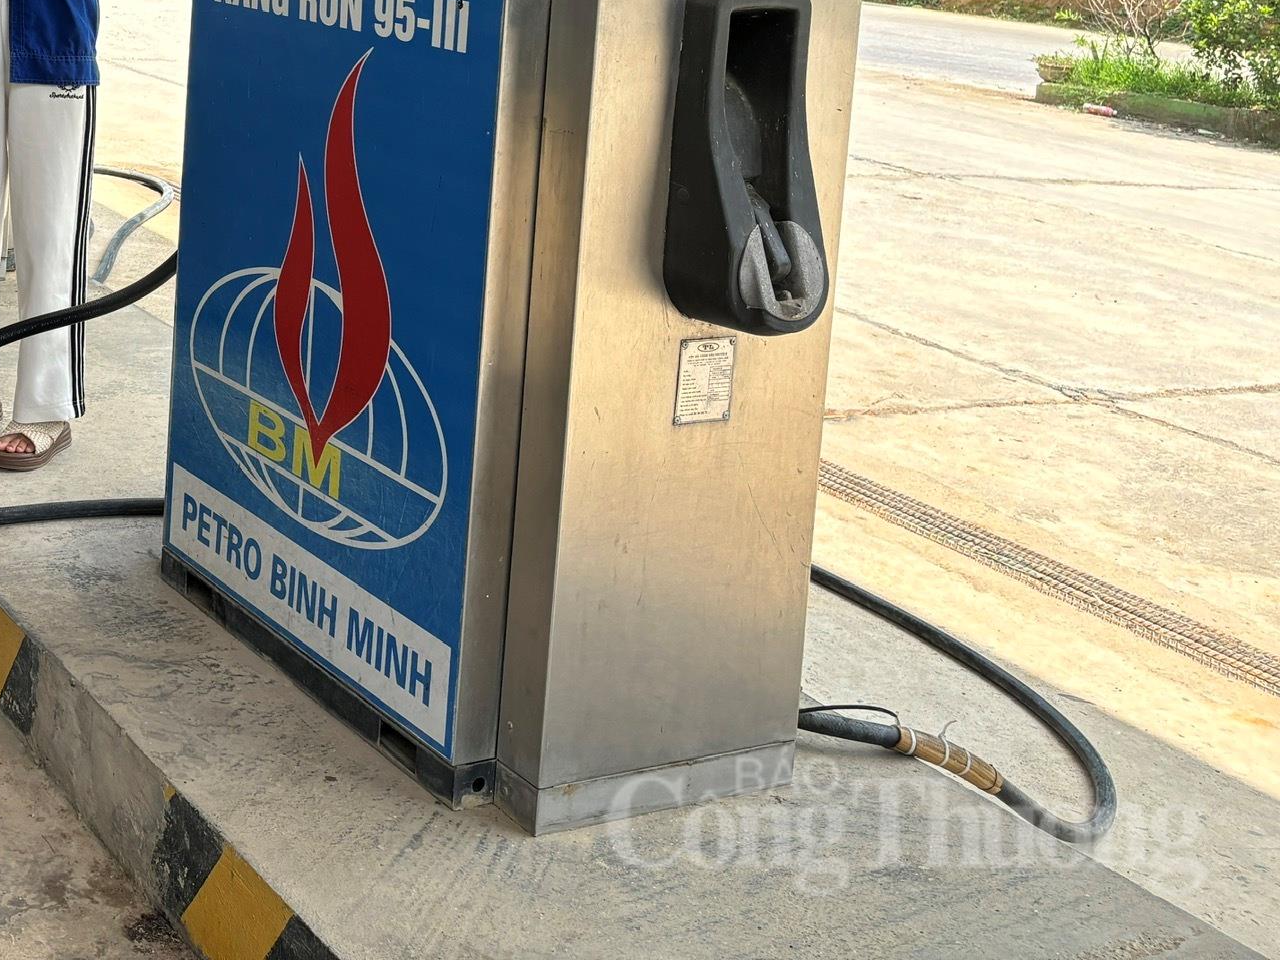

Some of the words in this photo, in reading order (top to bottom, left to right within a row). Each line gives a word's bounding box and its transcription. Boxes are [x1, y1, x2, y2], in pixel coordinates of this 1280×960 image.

[247, 399, 341, 501] BM
[182, 492, 262, 580] PETRO
[270, 552, 338, 638] BINH
[347, 606, 432, 708] MINH
